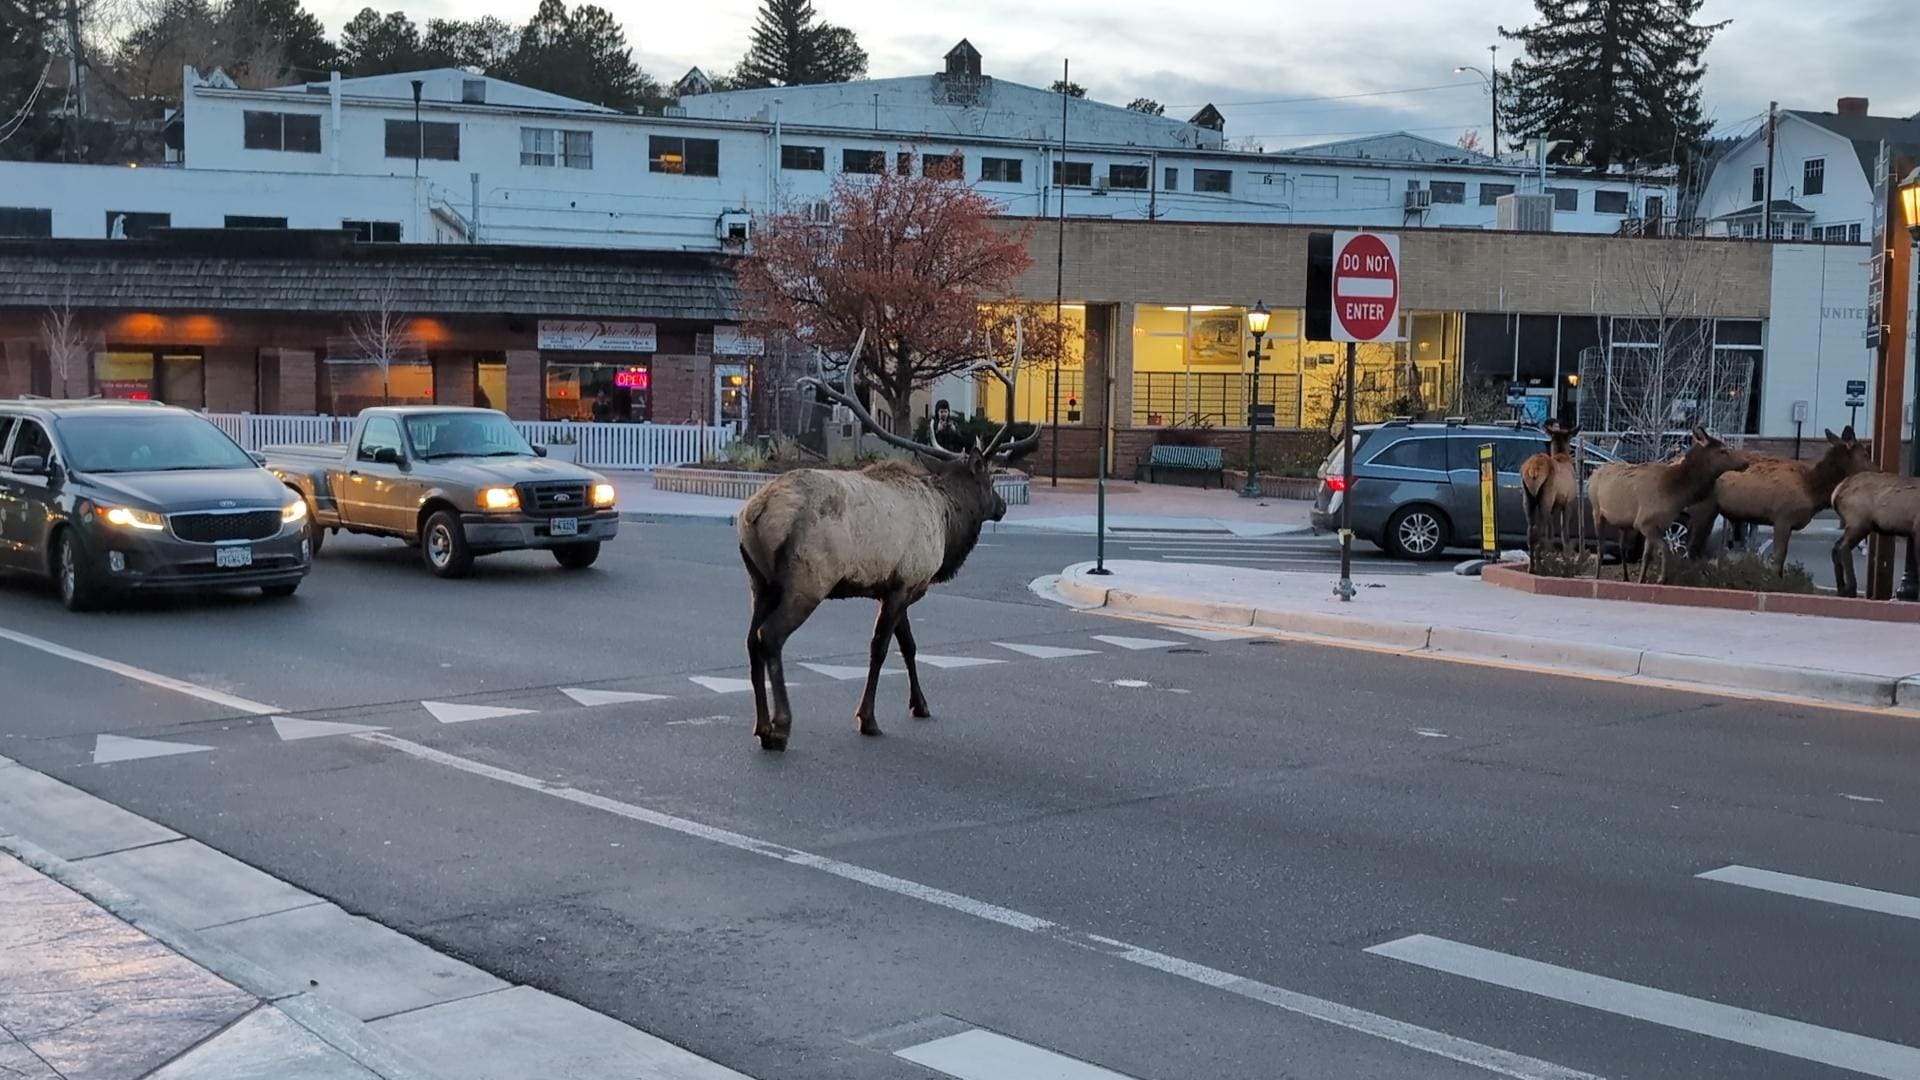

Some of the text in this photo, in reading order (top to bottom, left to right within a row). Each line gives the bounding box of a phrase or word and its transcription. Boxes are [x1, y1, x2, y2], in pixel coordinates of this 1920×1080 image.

[1343, 253, 1390, 273] DO NOT
[1346, 303, 1385, 321] ENTER
[616, 372, 648, 388] OPEN
